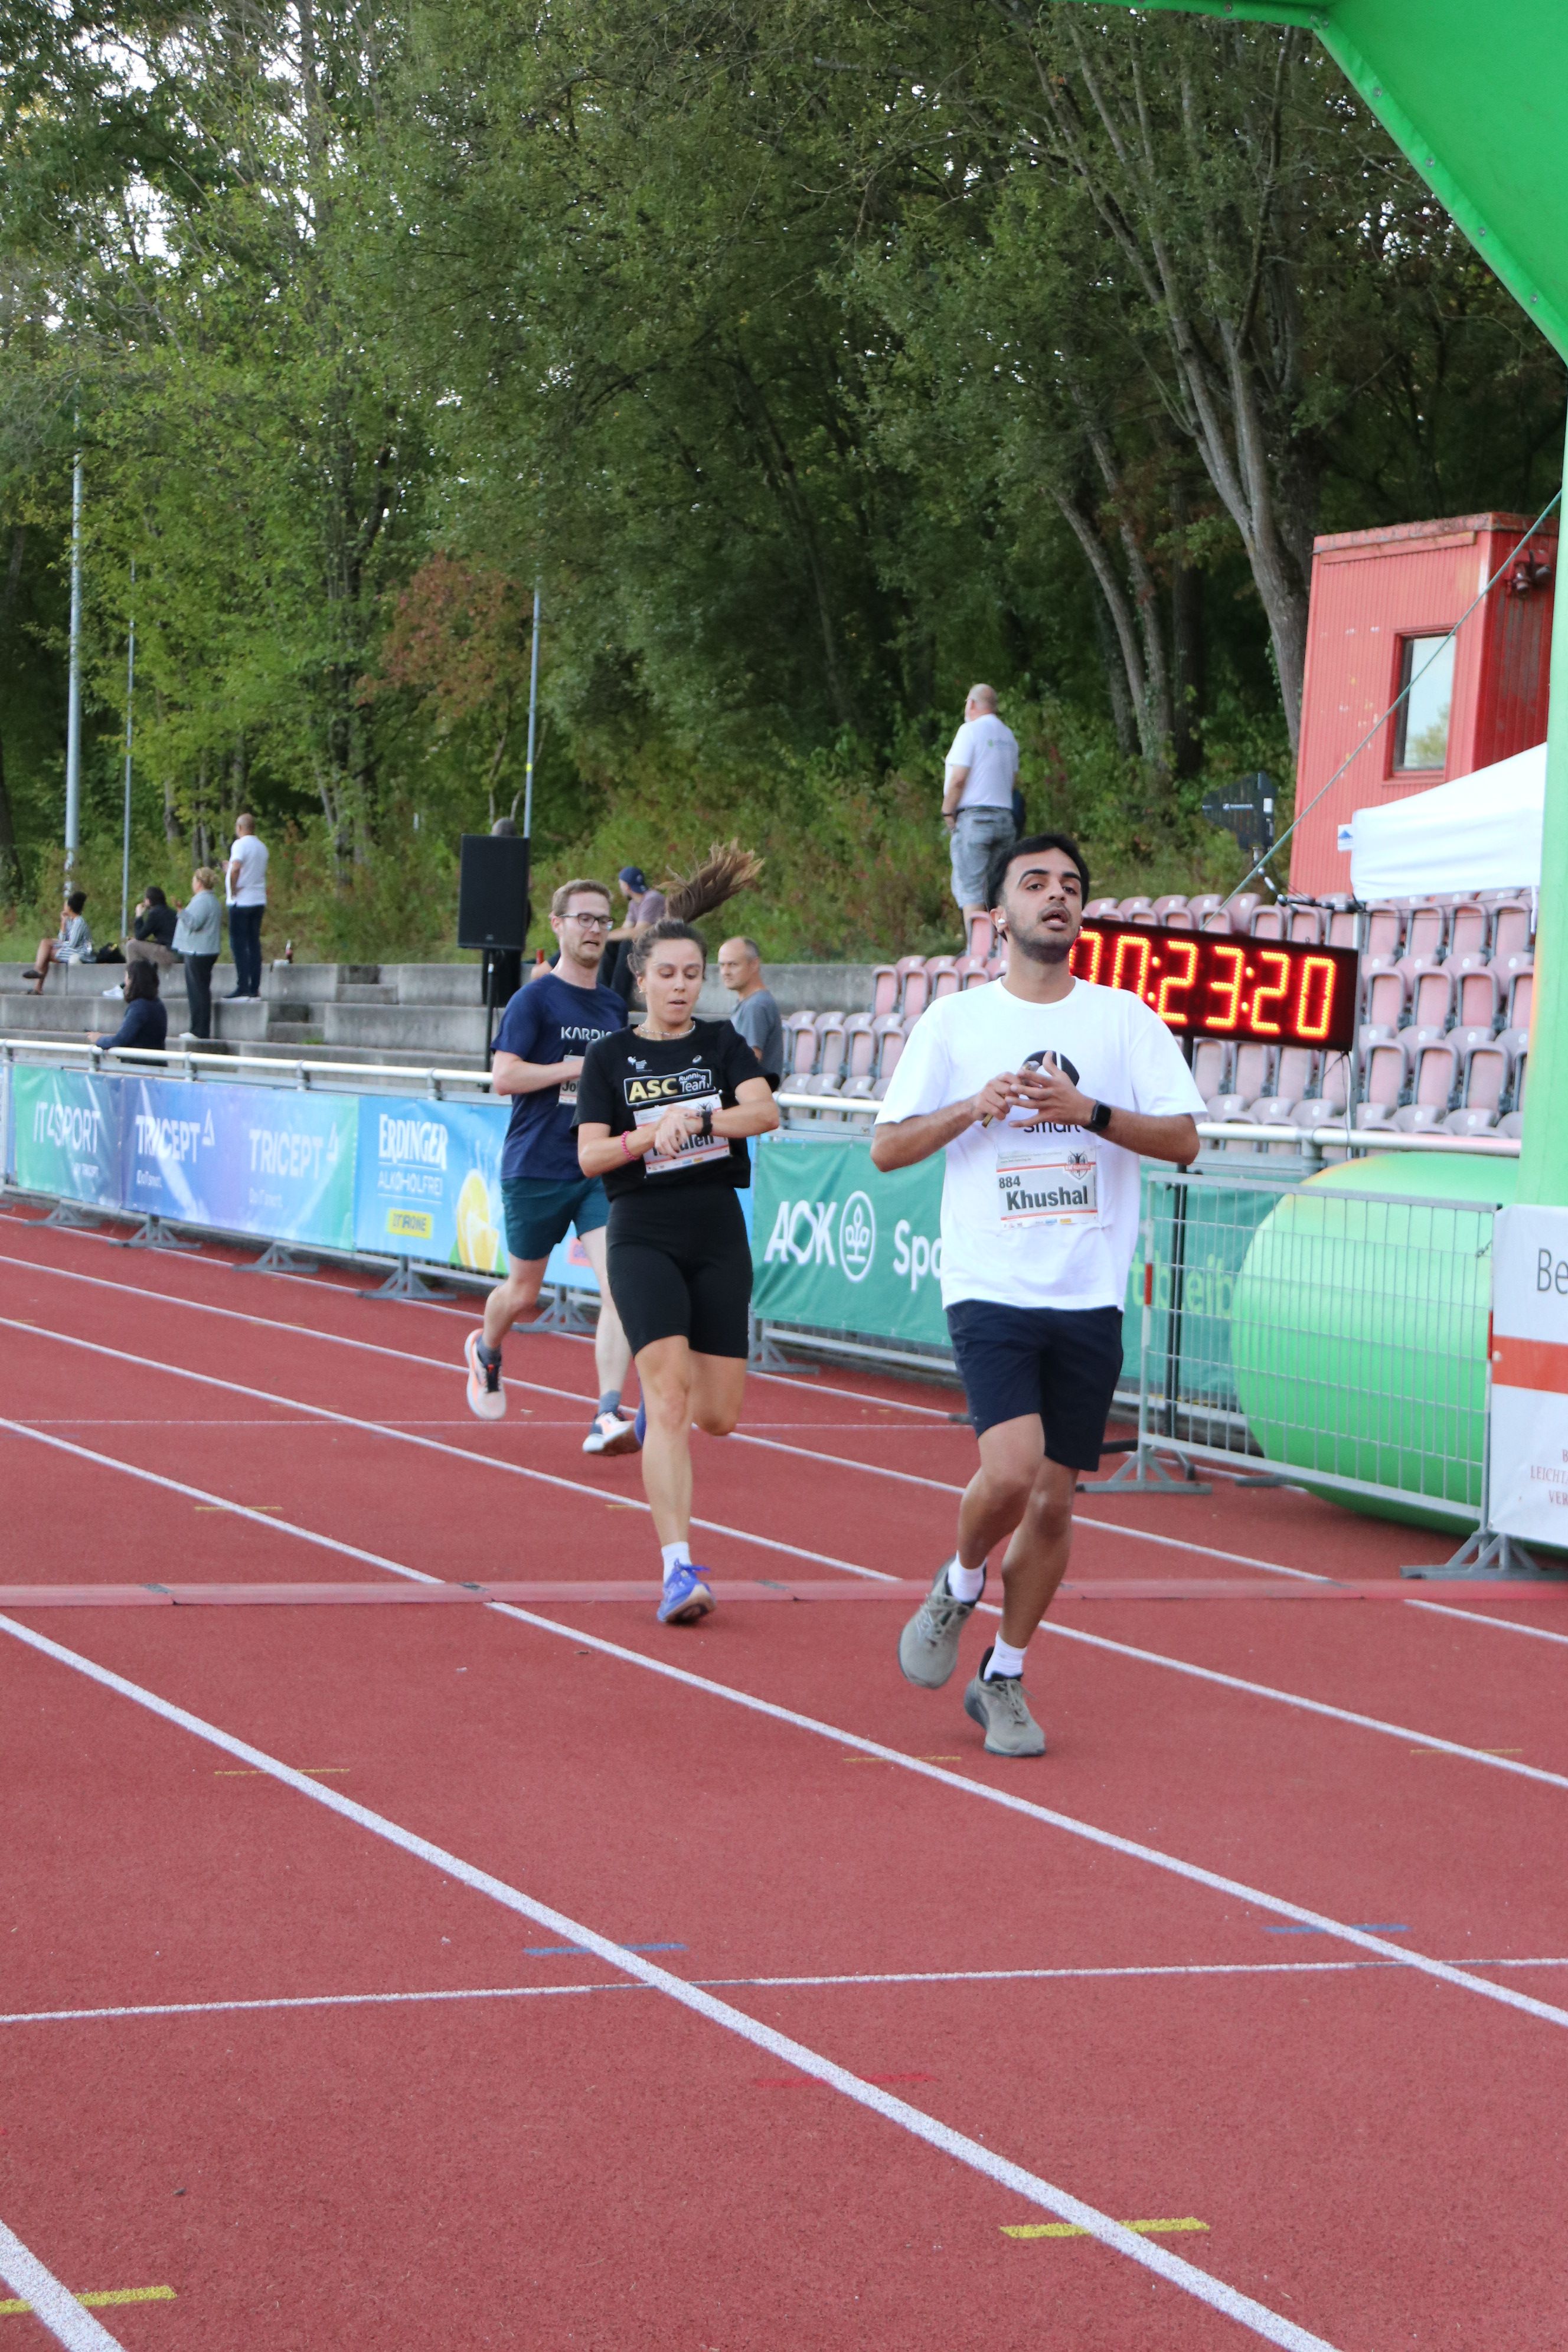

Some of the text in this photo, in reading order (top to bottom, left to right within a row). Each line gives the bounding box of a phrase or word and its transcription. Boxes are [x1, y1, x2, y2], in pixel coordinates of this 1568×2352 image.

[561, 1080, 579, 1092] Jo
[629, 1077, 678, 1102] ASC
[678, 1072, 706, 1082] Running
[135, 1114, 201, 1163] TRICEPT
[378, 1113, 449, 1171] ERDINGER
[249, 1128, 324, 1181] TRICEPT
[377, 1170, 443, 1197] ALKOHOLFREI
[999, 1175, 1021, 1190] 884
[1006, 1185, 1088, 1211] Khushal
[764, 1200, 838, 1266] AOK
